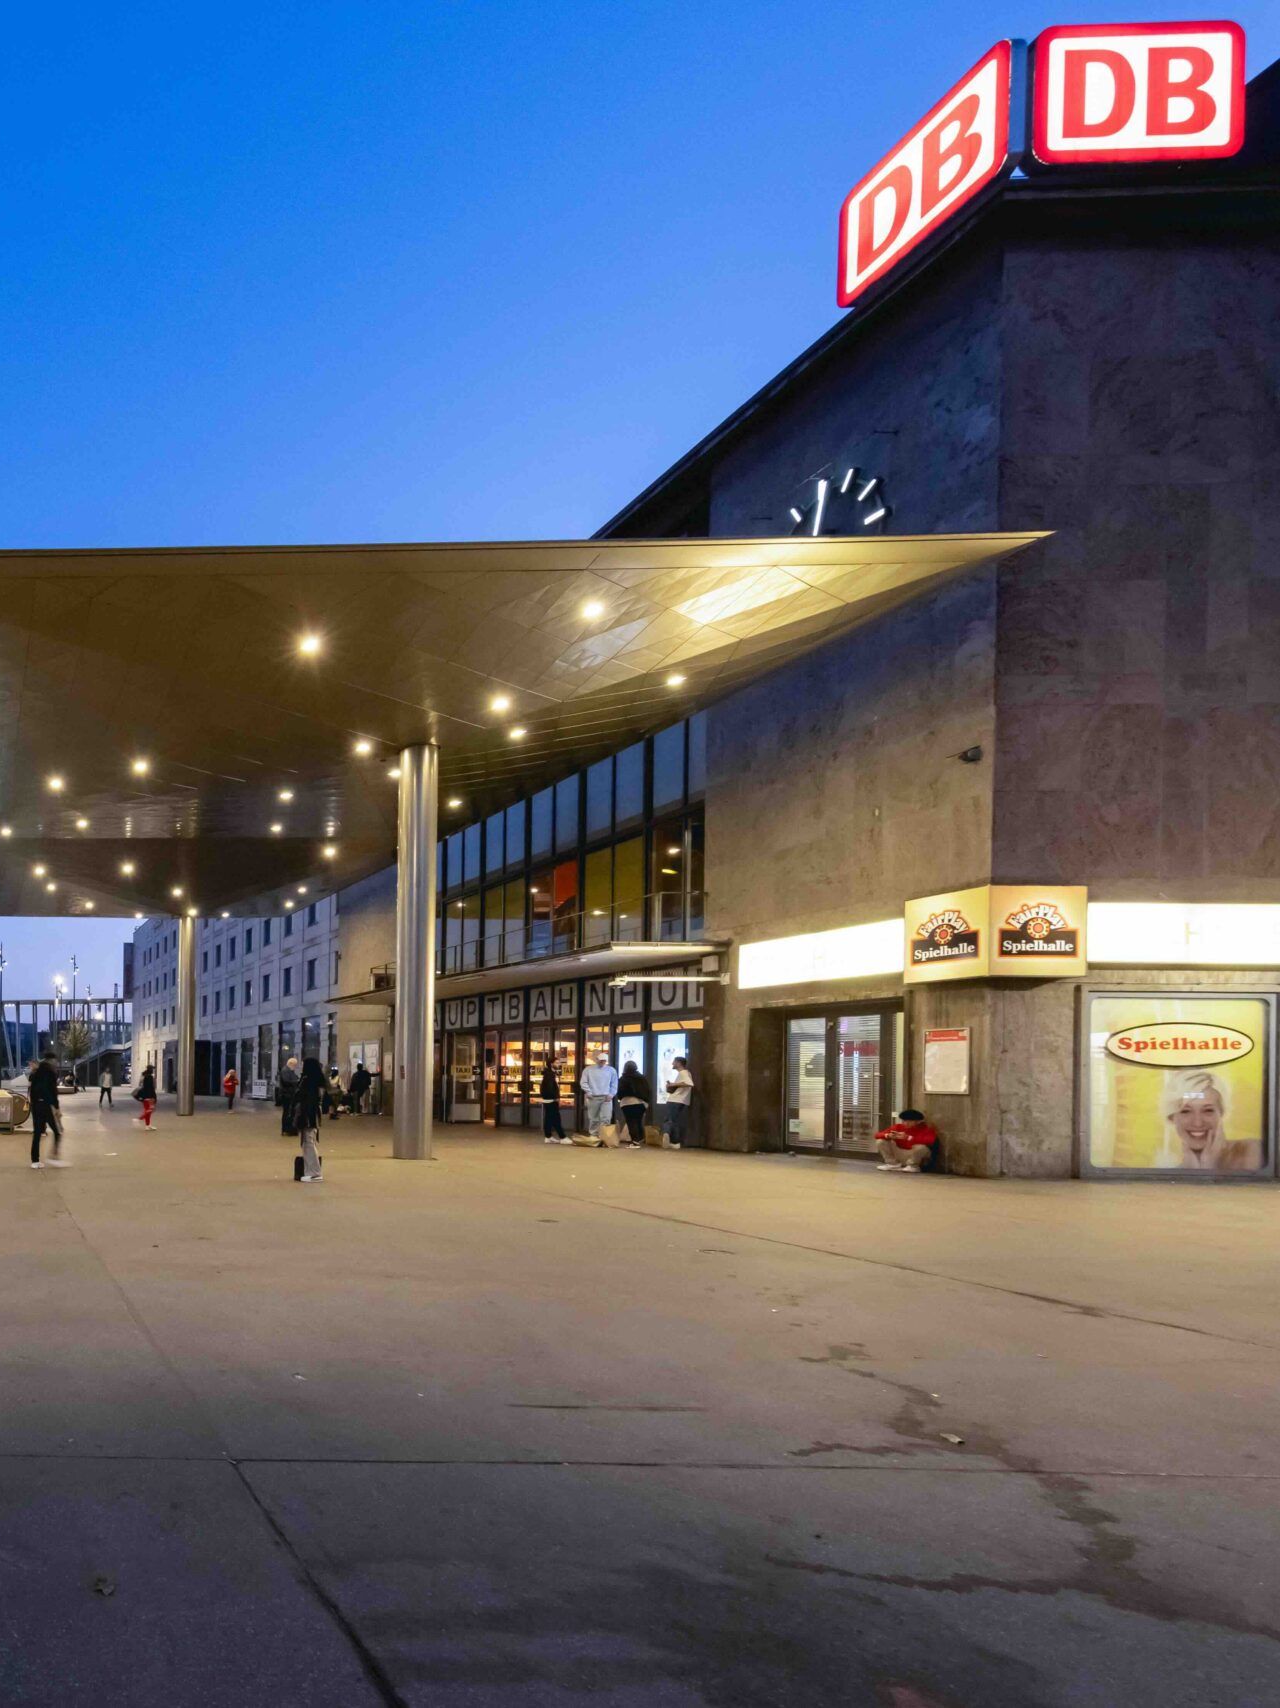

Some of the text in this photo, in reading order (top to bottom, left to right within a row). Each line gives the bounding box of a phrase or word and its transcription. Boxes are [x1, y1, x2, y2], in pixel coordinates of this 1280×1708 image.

[1061, 46, 1217, 139] DB
[856, 94, 982, 278] DB
[919, 911, 970, 938] FairPlay
[1007, 904, 1066, 930] FairPlay
[913, 942, 976, 961] Spielhalle
[1002, 939, 1074, 953] Spielhalle
[1118, 1037, 1242, 1053] Spielhalle
